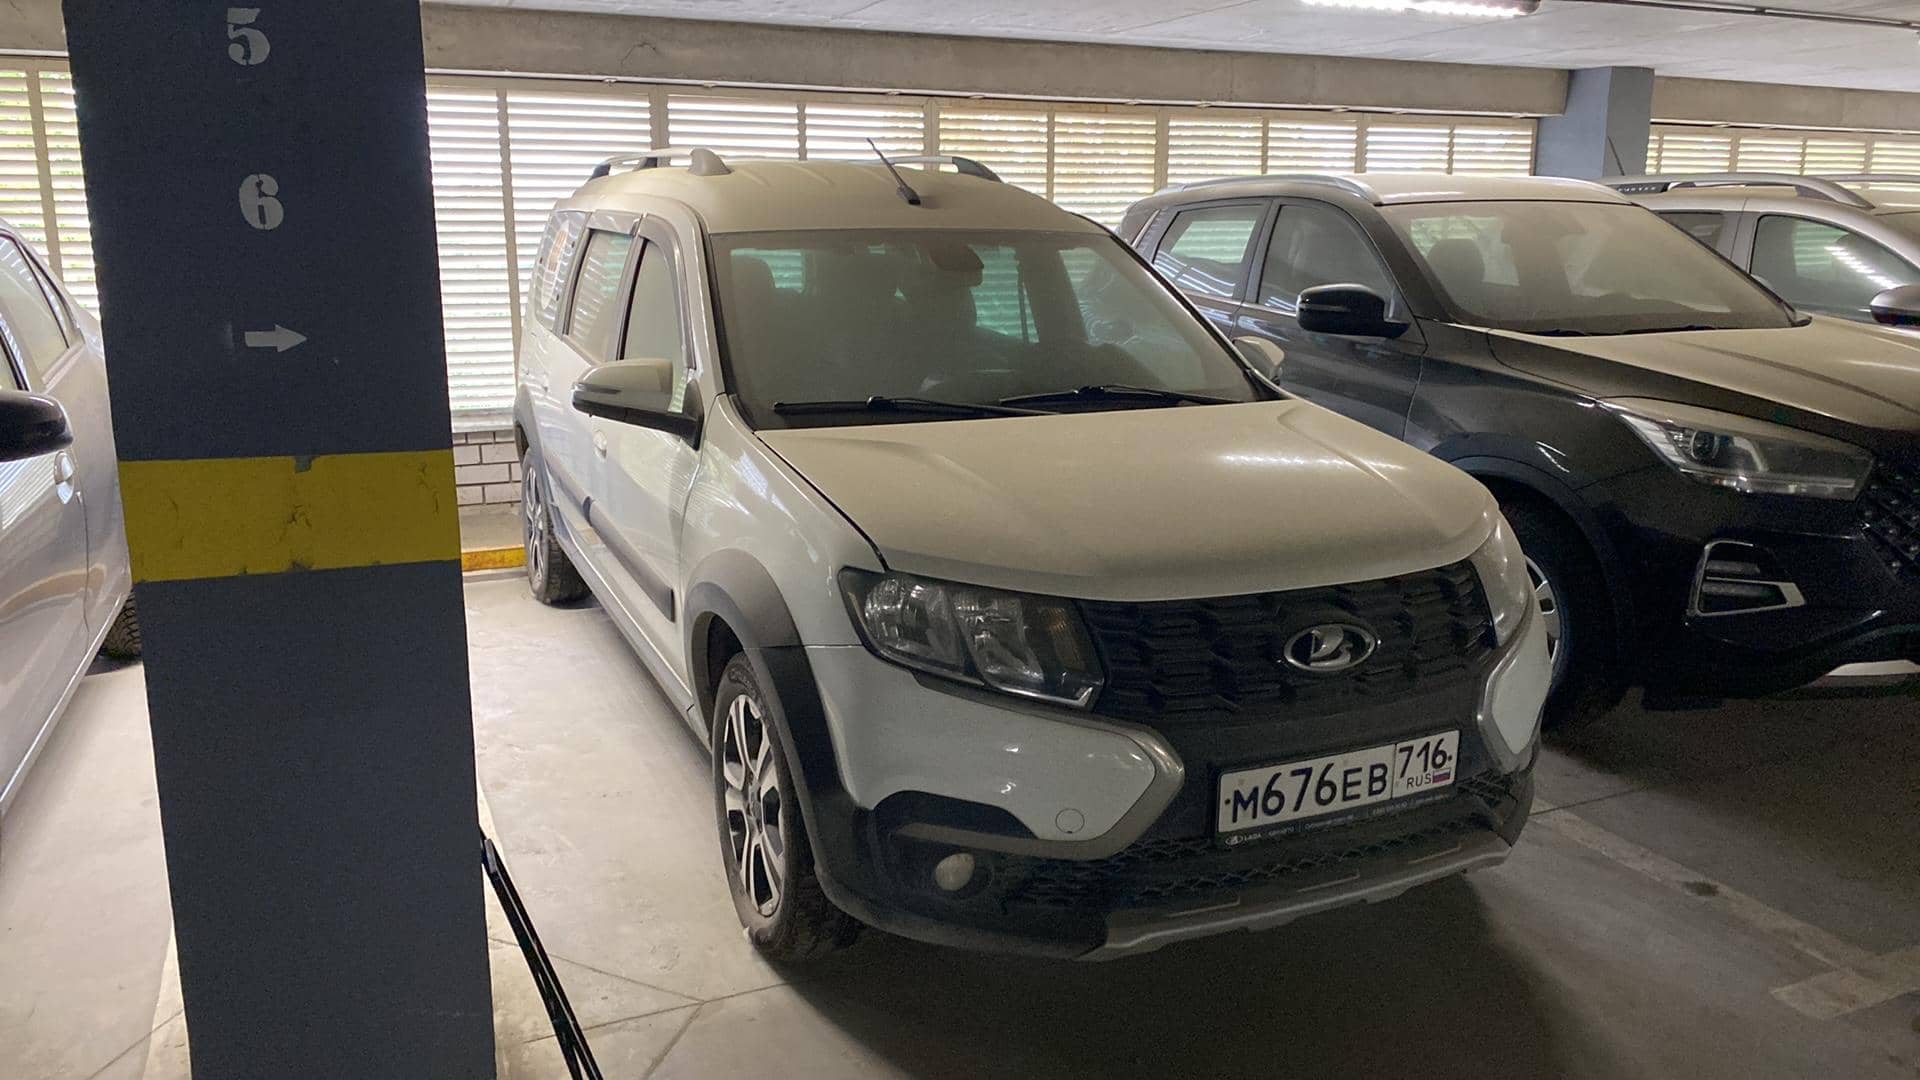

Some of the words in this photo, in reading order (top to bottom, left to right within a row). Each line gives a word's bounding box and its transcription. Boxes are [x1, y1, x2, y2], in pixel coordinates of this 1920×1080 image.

[227, 7, 271, 66] 5
[238, 173, 284, 231] 6
[1398, 738, 1448, 778] 716
[1406, 773, 1432, 789] RUS
